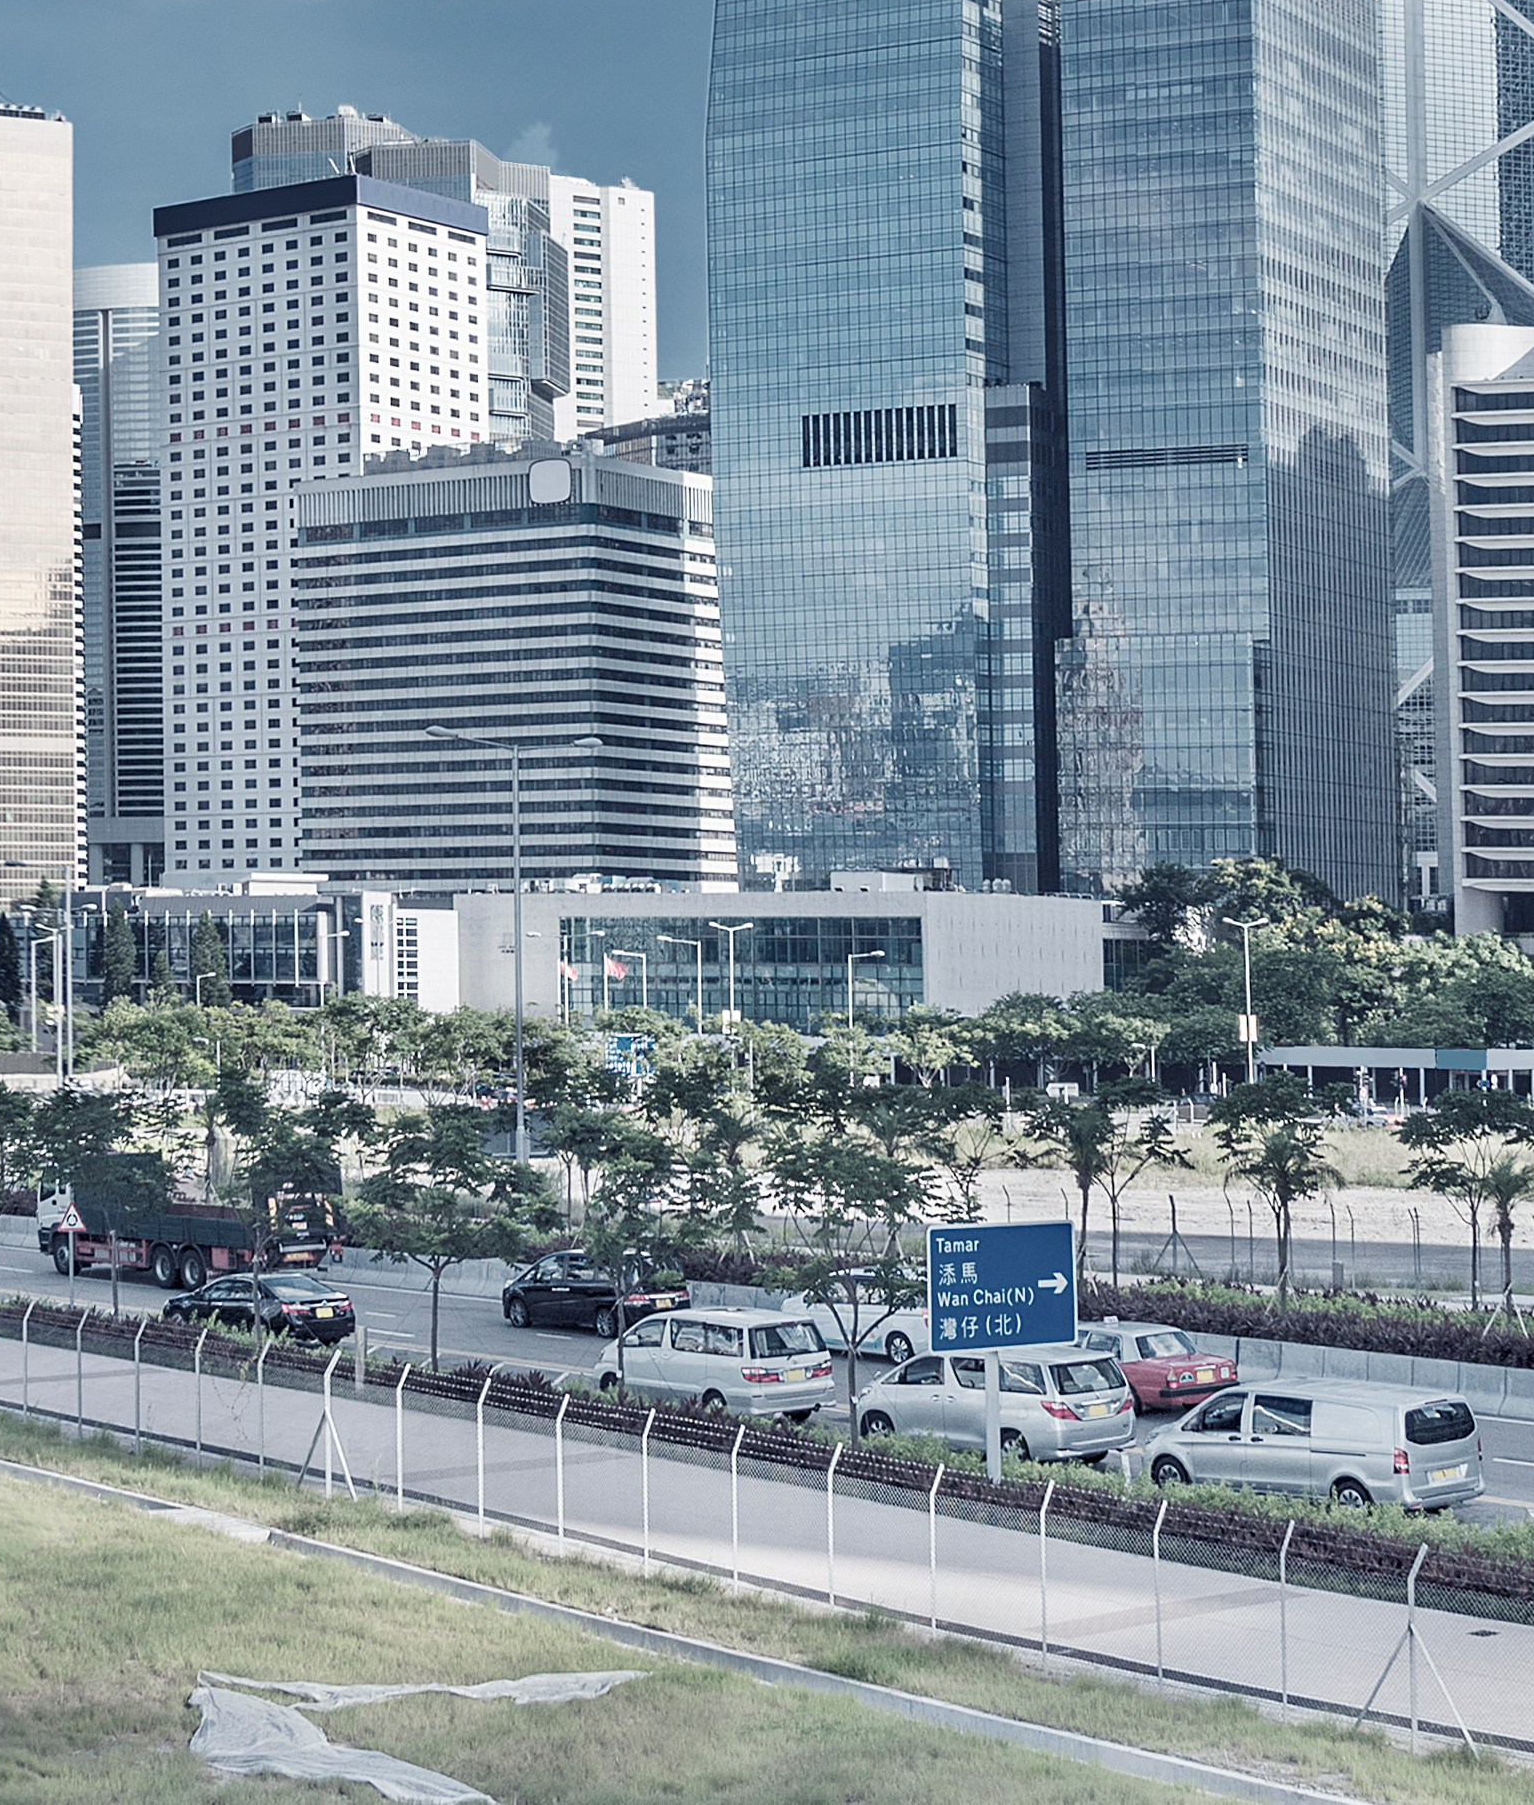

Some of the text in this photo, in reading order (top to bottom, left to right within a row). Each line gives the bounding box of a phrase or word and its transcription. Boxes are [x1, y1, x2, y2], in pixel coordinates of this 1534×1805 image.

[936, 1238, 980, 1253] Tamar
[939, 1262, 978, 1286] 添馬
[937, 1287, 1034, 1307] Wan Chai(N)
